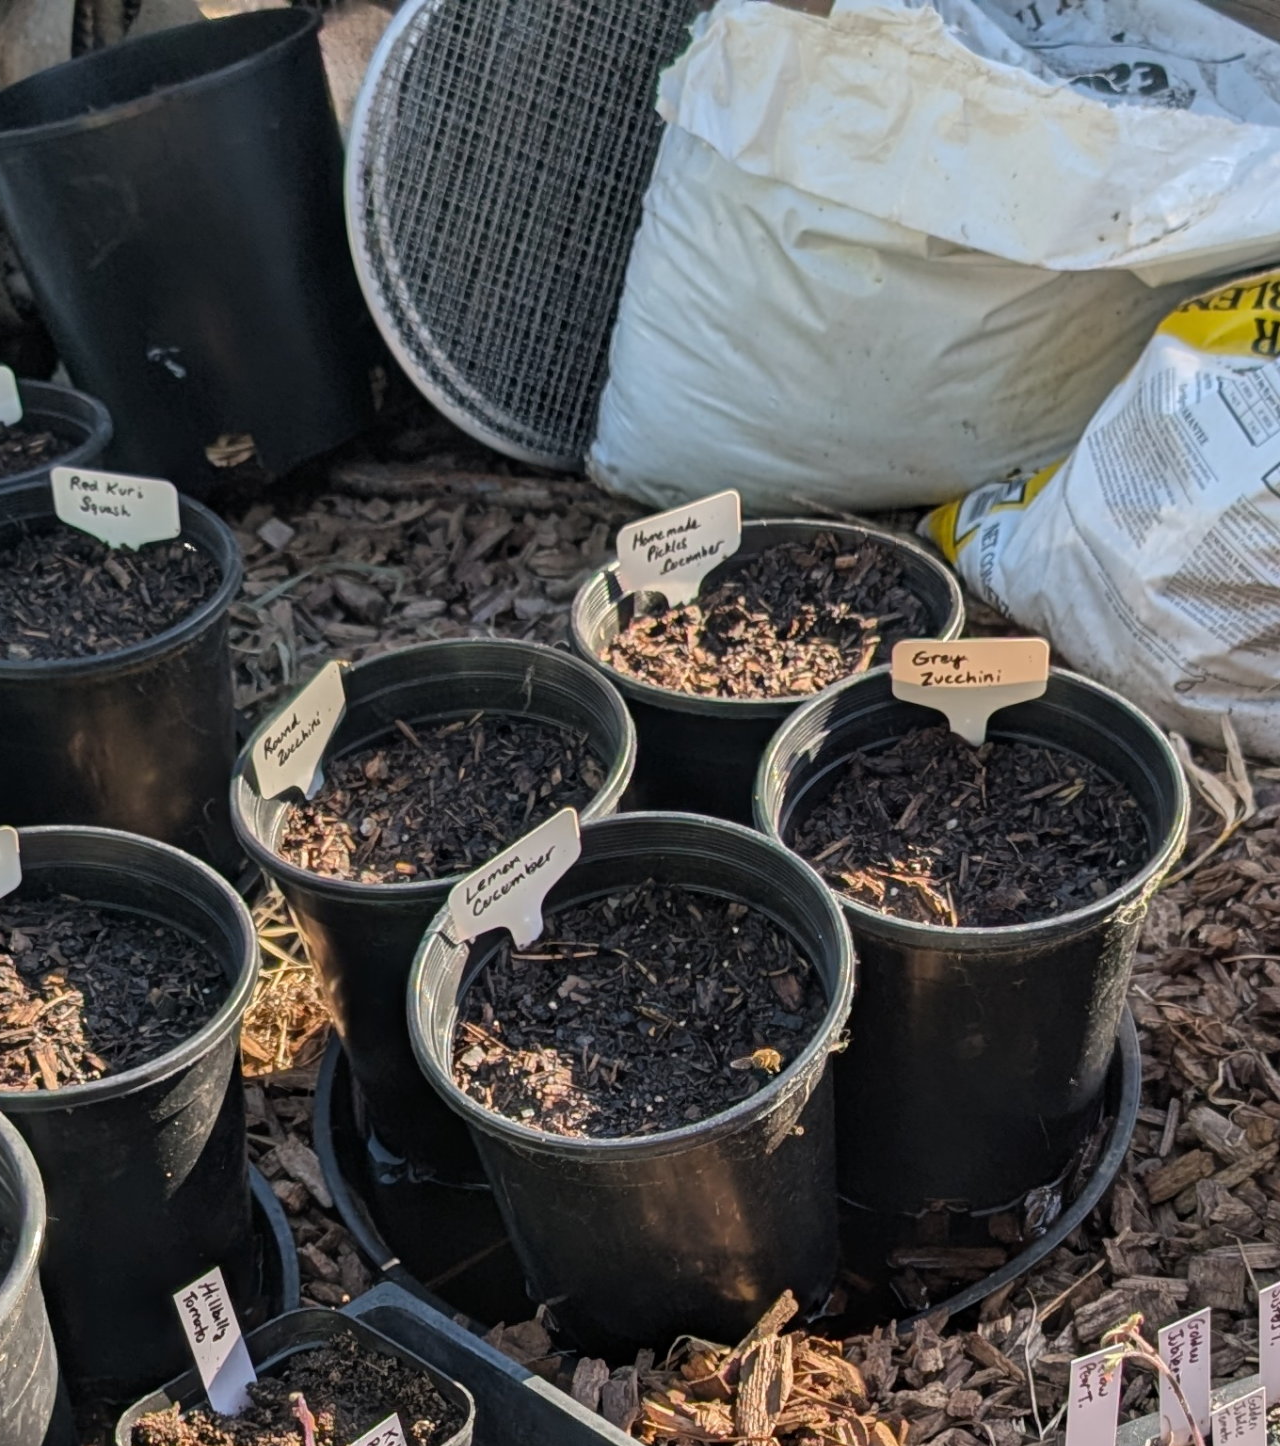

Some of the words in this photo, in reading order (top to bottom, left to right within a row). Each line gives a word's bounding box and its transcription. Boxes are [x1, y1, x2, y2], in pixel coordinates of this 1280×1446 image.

[70, 475, 99, 492] Red
[106, 482, 144, 500] Kuri
[80, 495, 131, 518] Squash
[646, 537, 688, 563] Pickles
[911, 649, 968, 670] Grey
[920, 668, 1003, 687] Zucchini
[263, 712, 301, 761] Round
[276, 710, 322, 768] Zucchini
[465, 854, 522, 906] Lemon
[181, 1291, 207, 1344] Tomato
